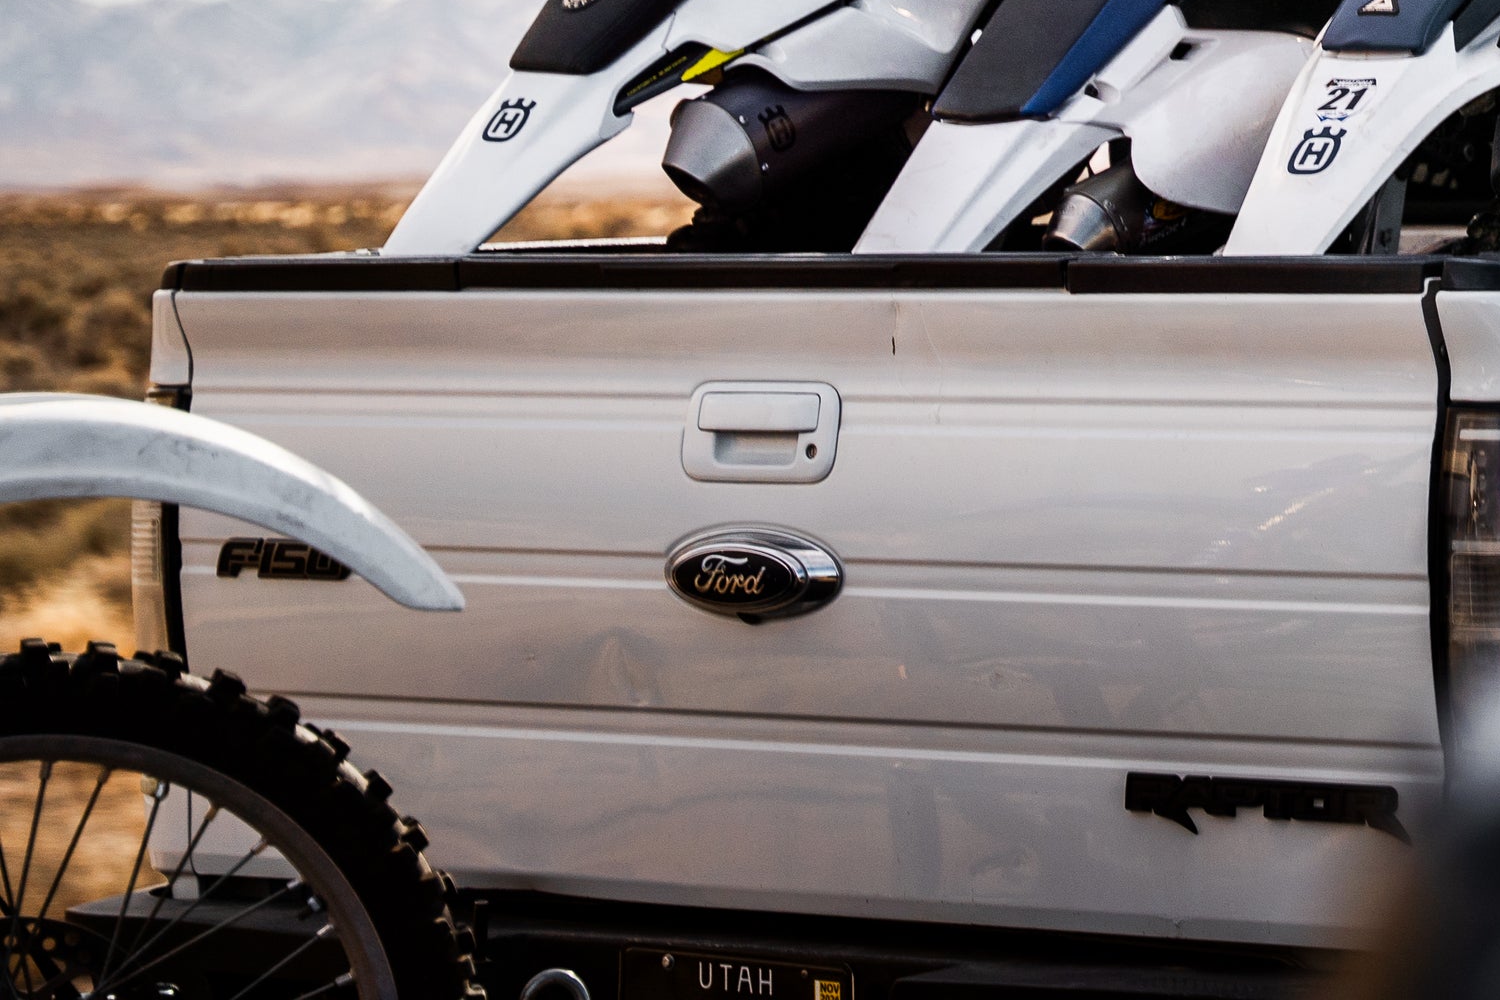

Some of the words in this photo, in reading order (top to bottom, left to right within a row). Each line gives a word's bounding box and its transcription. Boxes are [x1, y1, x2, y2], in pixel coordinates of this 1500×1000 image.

[1317, 88, 1368, 111] 21
[694, 554, 767, 595] Ford
[1125, 771, 1412, 848] RAPTOR
[699, 961, 773, 997] UTAH
[820, 982, 839, 994] NOV
